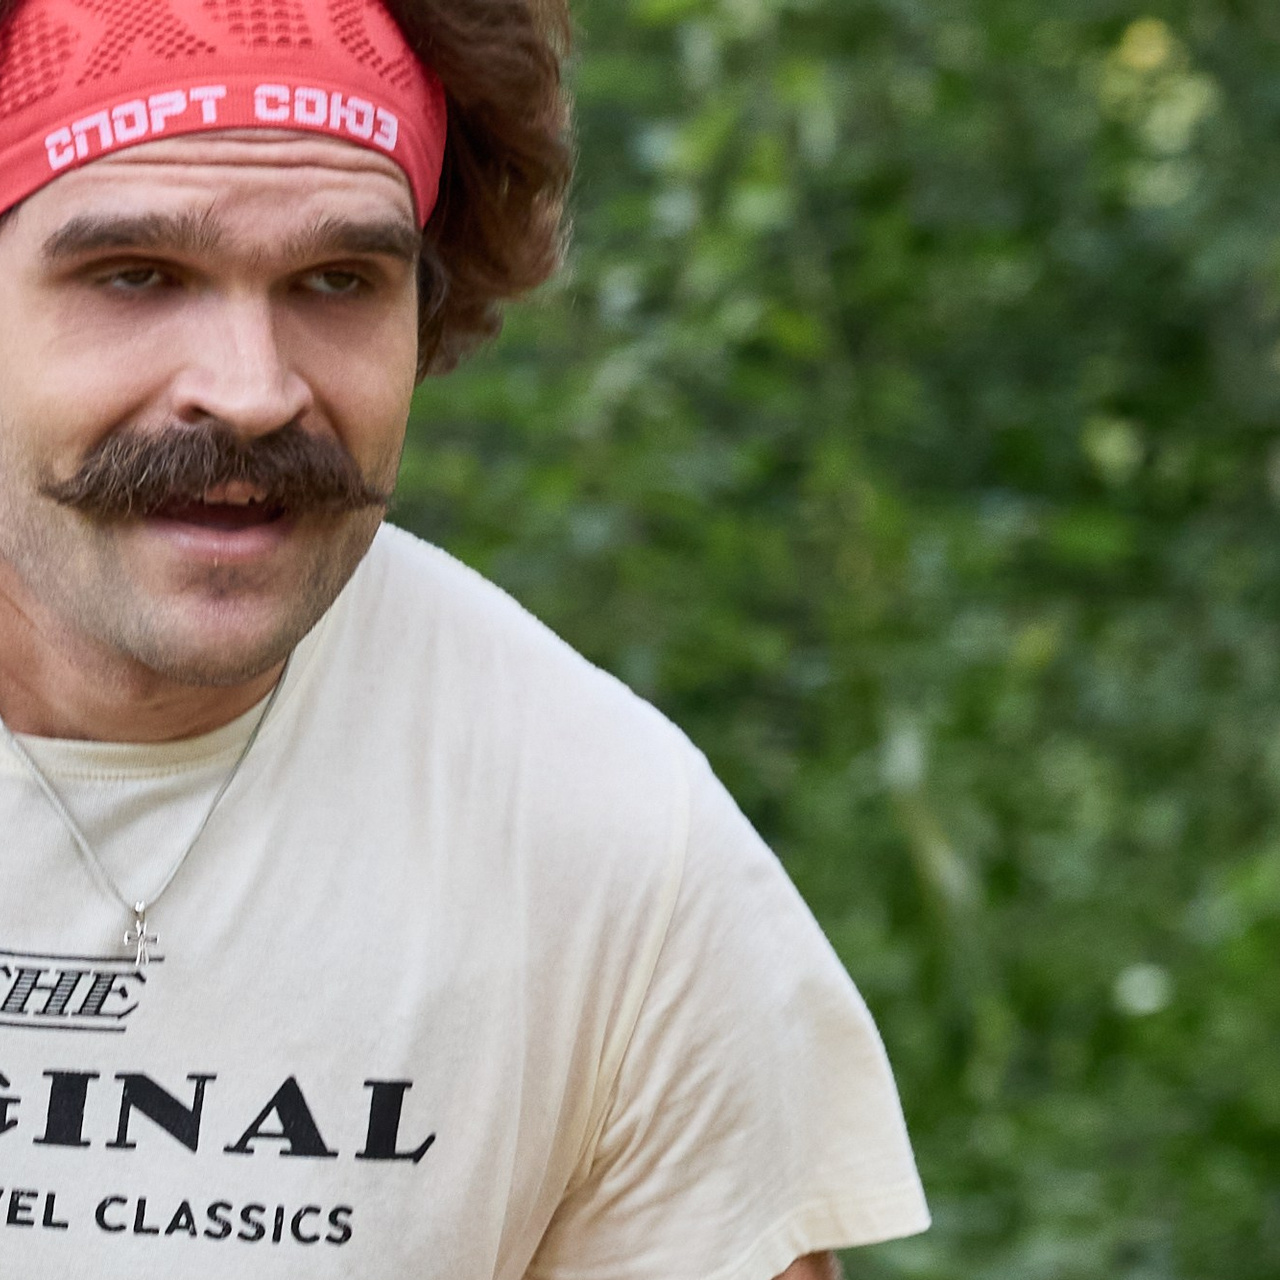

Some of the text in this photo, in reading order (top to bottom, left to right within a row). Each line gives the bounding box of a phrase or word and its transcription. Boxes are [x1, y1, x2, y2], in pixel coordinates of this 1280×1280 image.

[44, 83, 399, 171] СПОРТ СОЮЗ
[95, 1197, 352, 1245] CLASSICS
